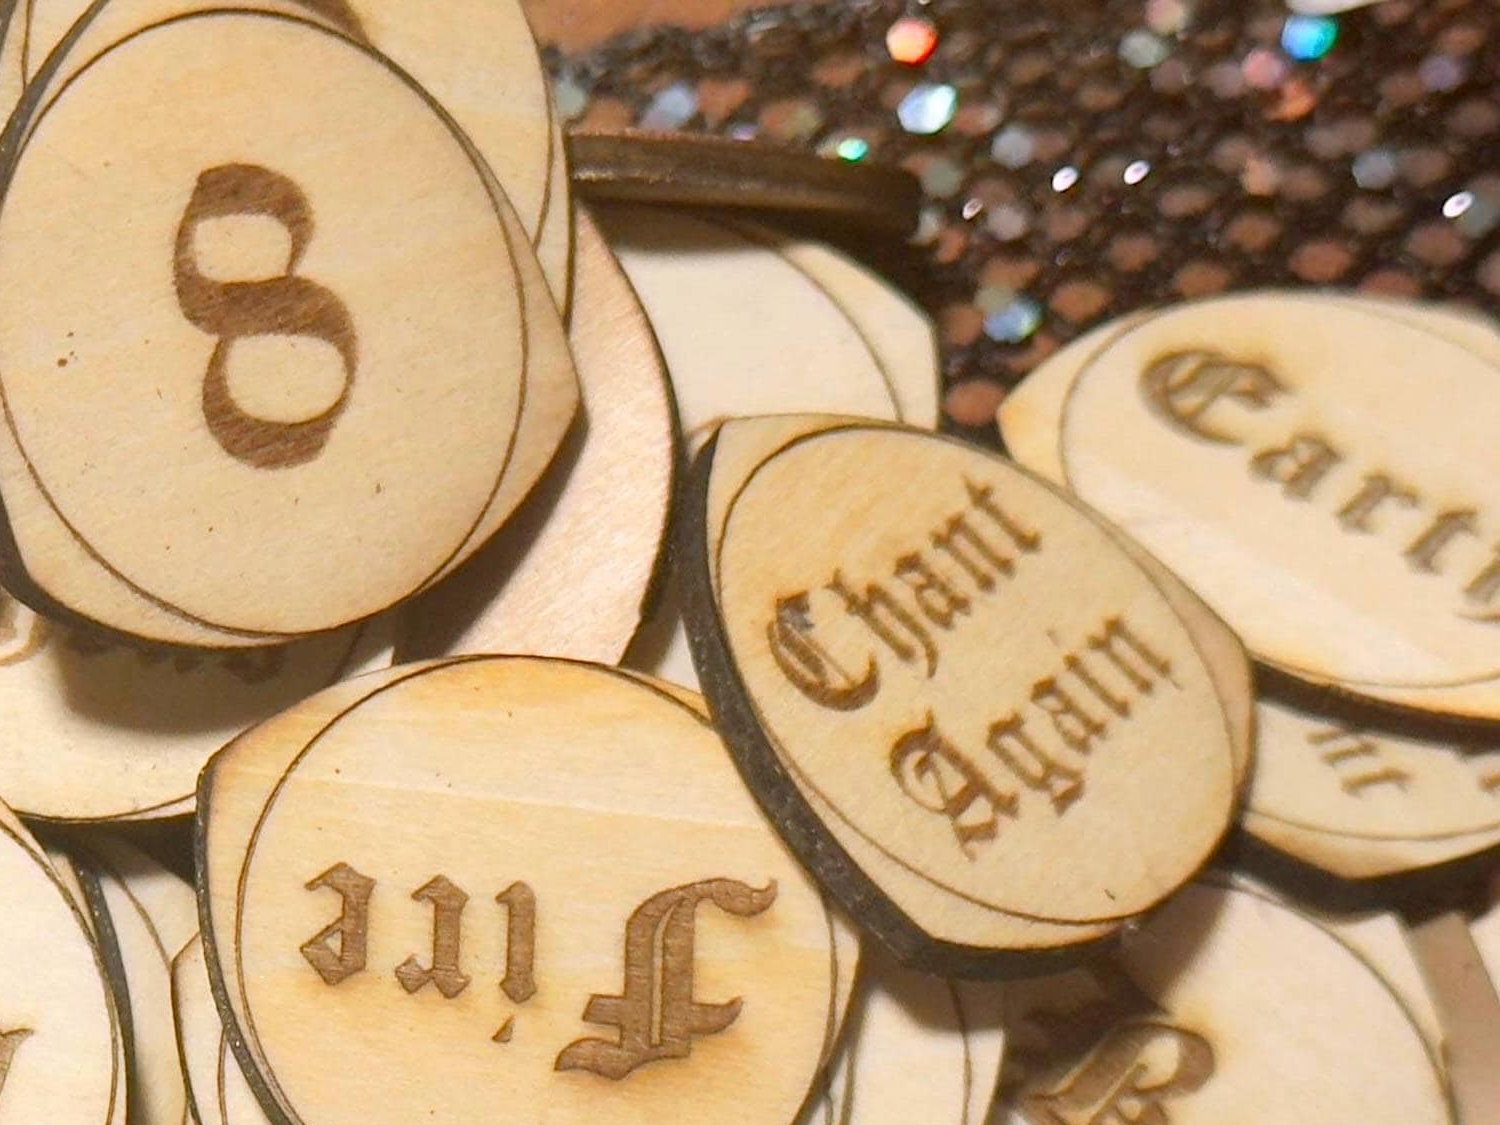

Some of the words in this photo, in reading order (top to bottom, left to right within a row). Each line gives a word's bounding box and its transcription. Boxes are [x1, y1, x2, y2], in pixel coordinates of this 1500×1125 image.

[174, 162, 358, 470] 8
[766, 474, 1042, 712] Chant
[889, 612, 1184, 862] Again
[300, 862, 778, 1081] Fire
